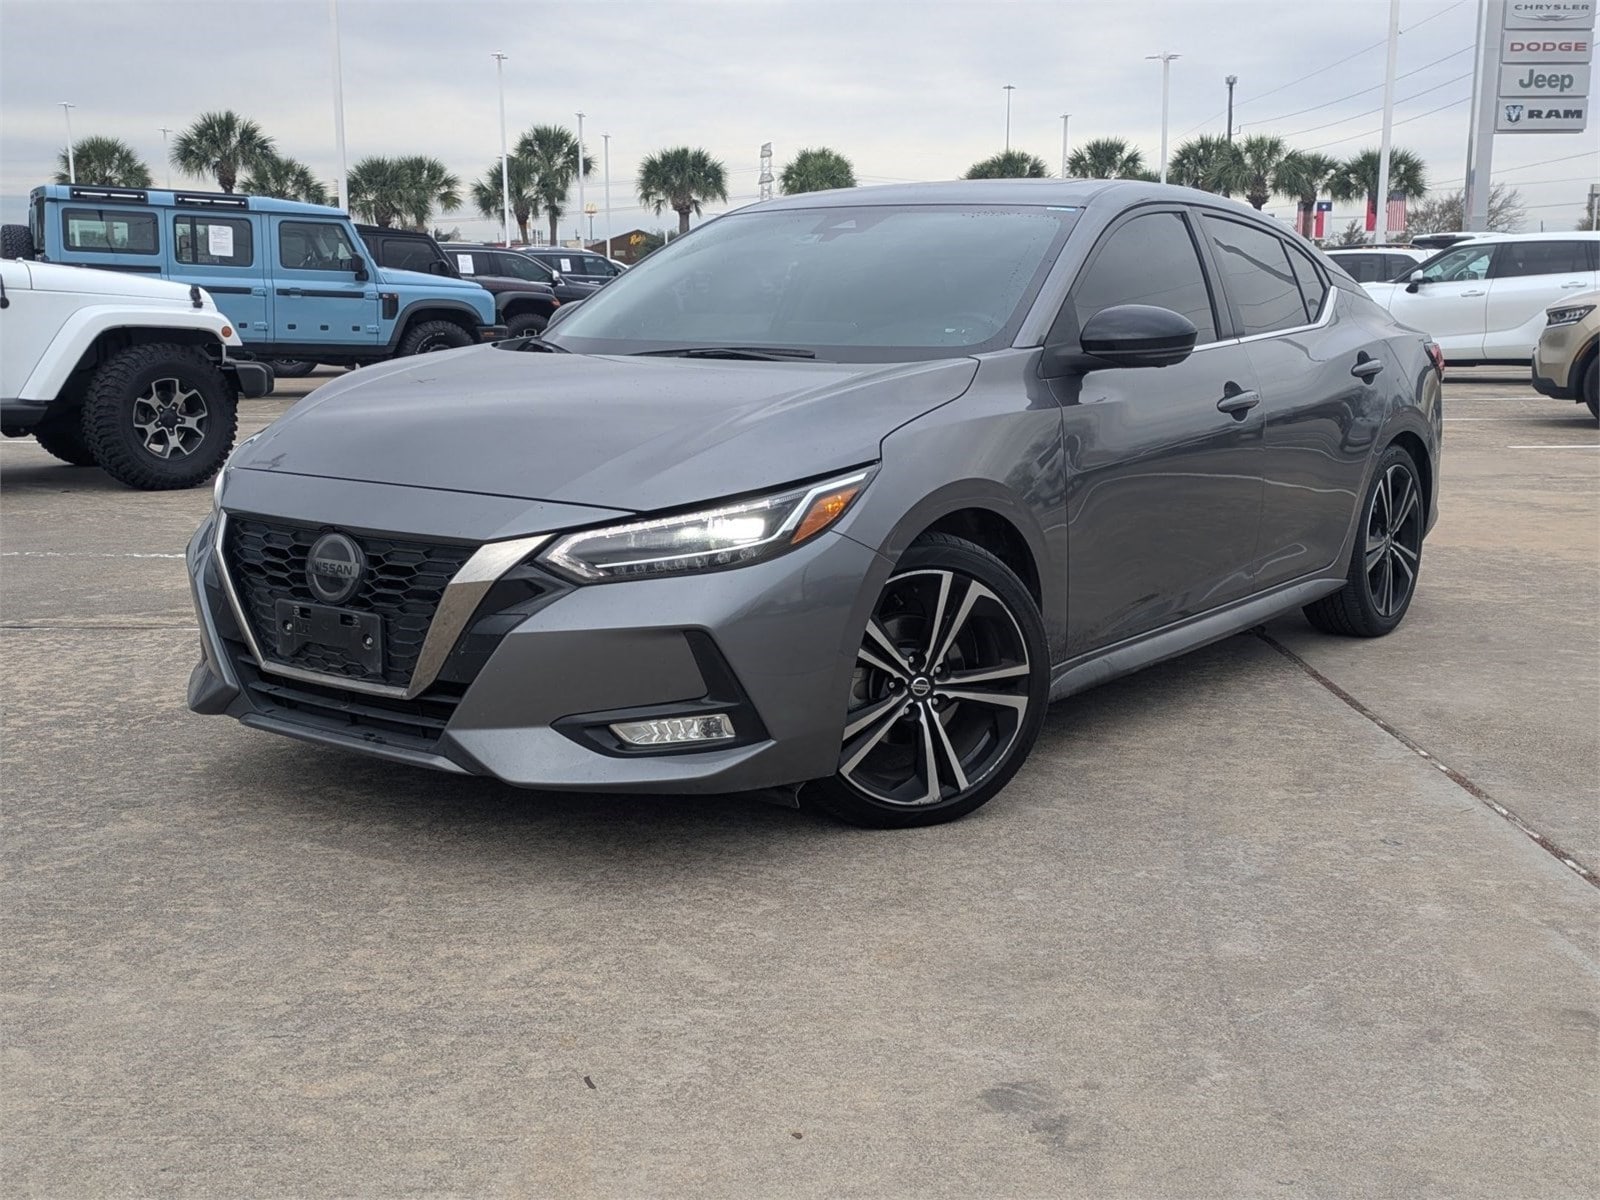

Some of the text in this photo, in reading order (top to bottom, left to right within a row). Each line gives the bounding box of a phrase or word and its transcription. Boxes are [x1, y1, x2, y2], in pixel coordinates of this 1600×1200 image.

[1510, 42, 1587, 52] DODGE
[1518, 69, 1574, 92] Jeep
[1527, 109, 1583, 119] RAM
[311, 560, 353, 576] NISSAN
